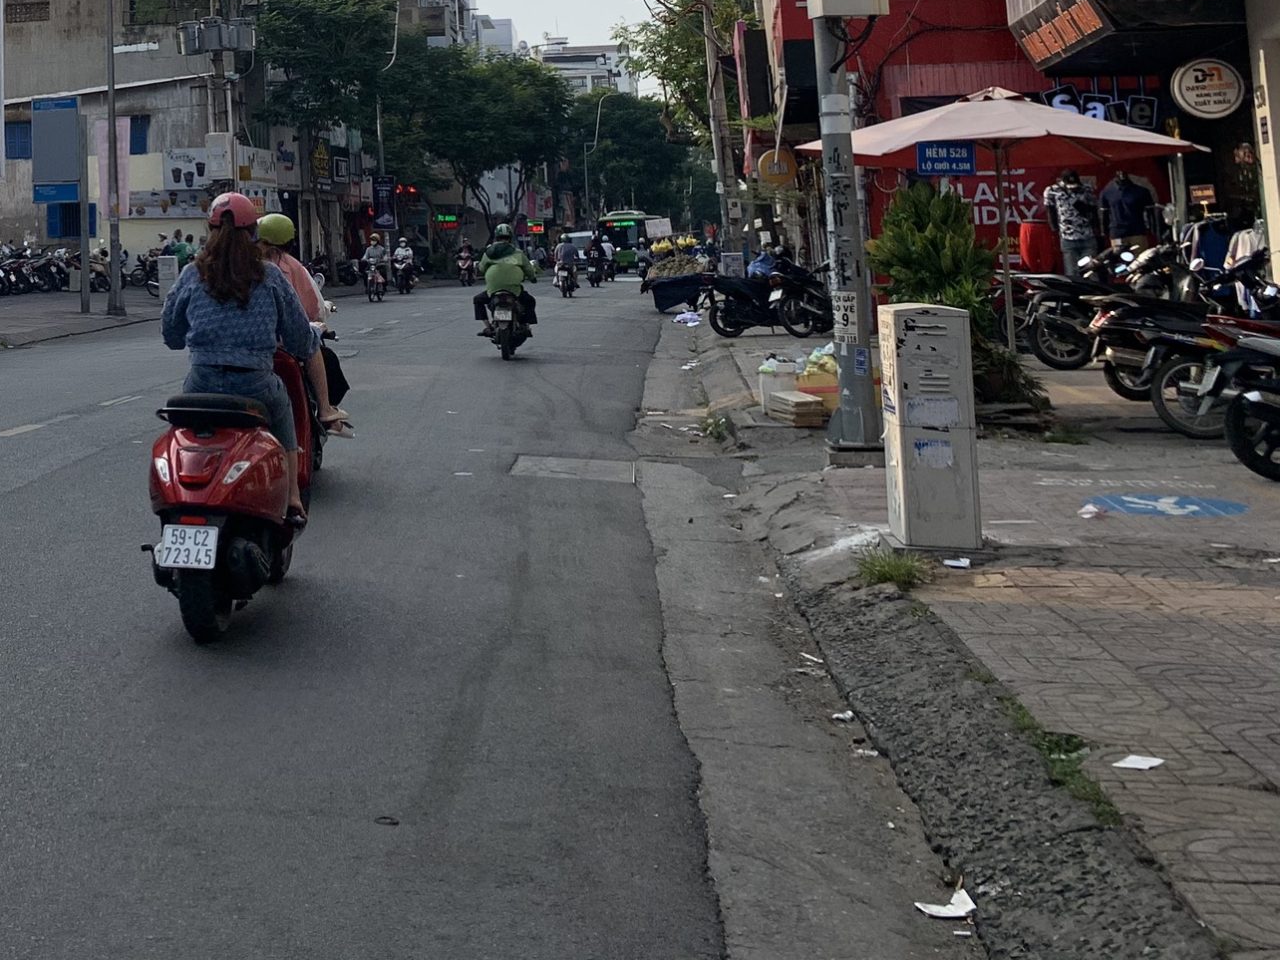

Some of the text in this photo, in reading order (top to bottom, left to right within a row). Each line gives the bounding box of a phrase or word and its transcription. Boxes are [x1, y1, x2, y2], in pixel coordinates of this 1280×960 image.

[949, 147, 968, 158] 528
[942, 179, 1038, 204] LACK
[973, 205, 1039, 226] IDAY
[163, 546, 213, 566] 723.45
